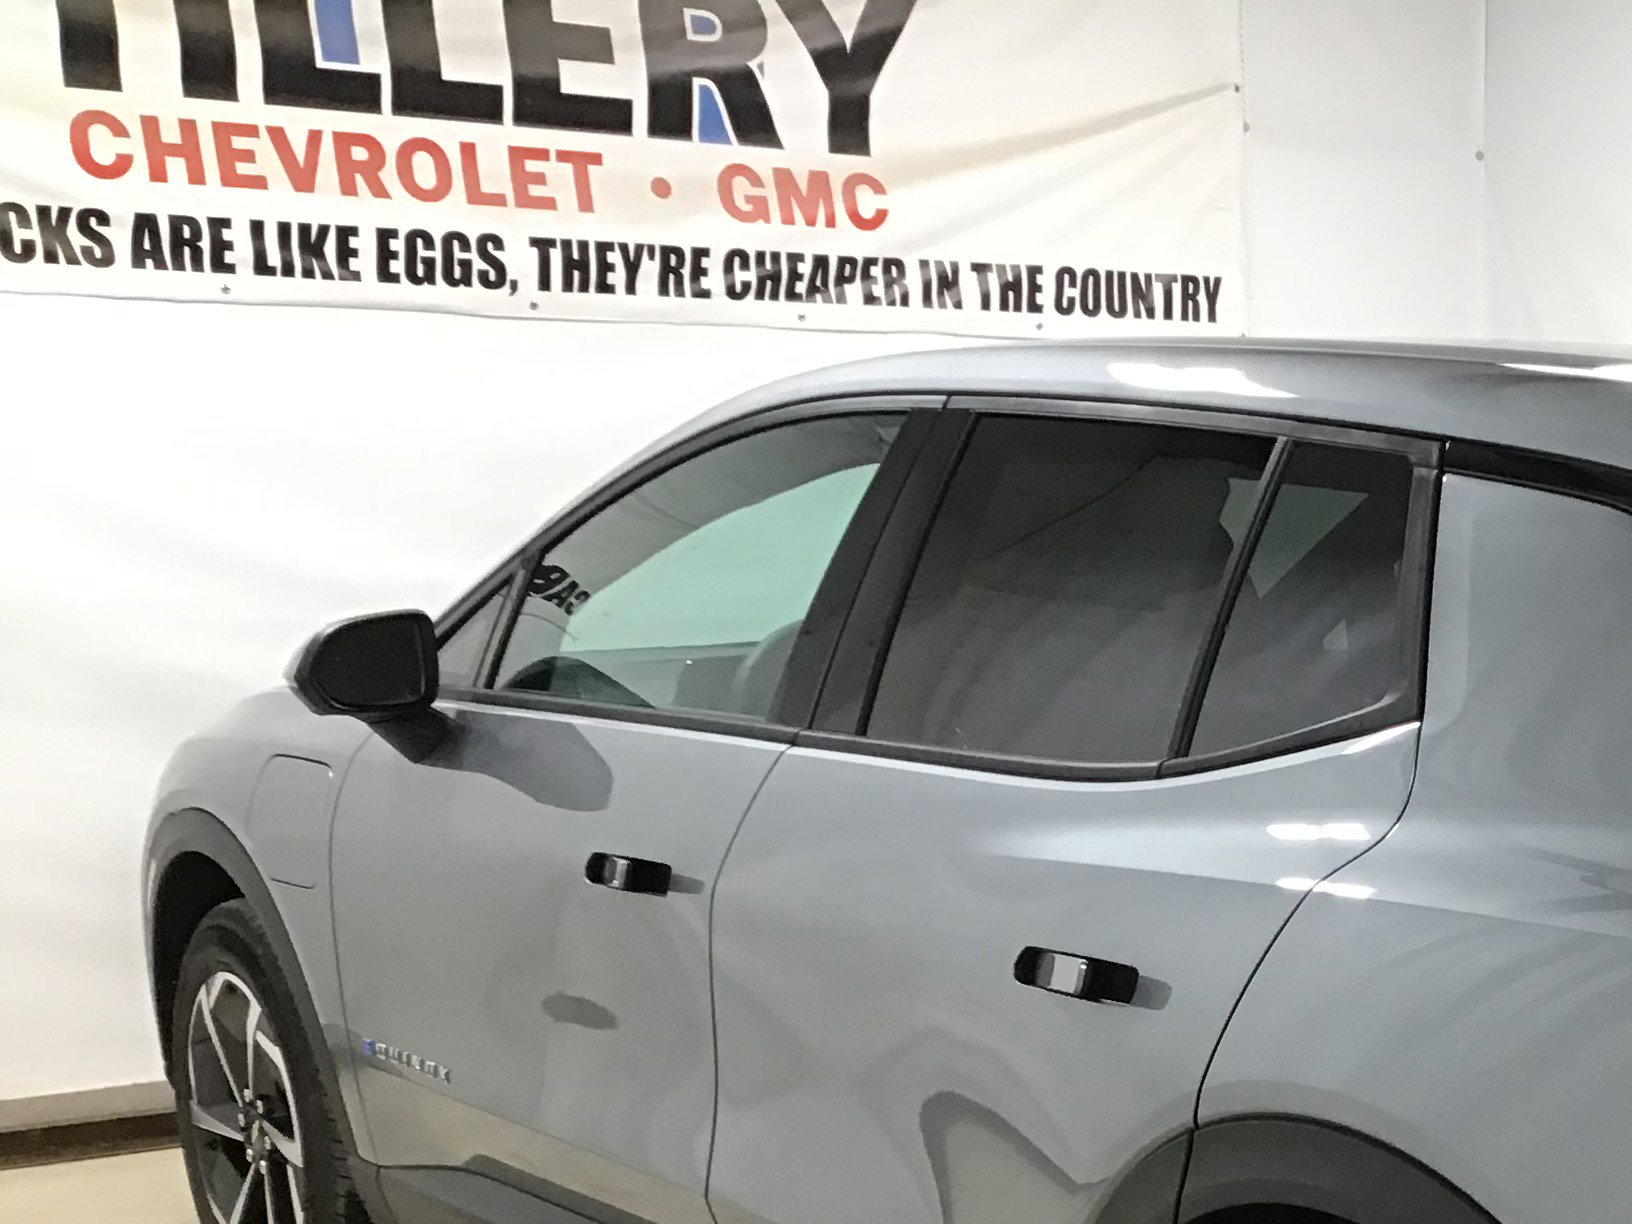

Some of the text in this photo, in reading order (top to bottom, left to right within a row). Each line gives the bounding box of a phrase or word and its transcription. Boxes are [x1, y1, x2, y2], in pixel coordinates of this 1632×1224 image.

[70, 110, 889, 232] CHEVROLET GMC
[0, 202, 1222, 324] CKS ARE LIKE EGGS, THEY'RE CHEAPER IN THE COUNTRY
